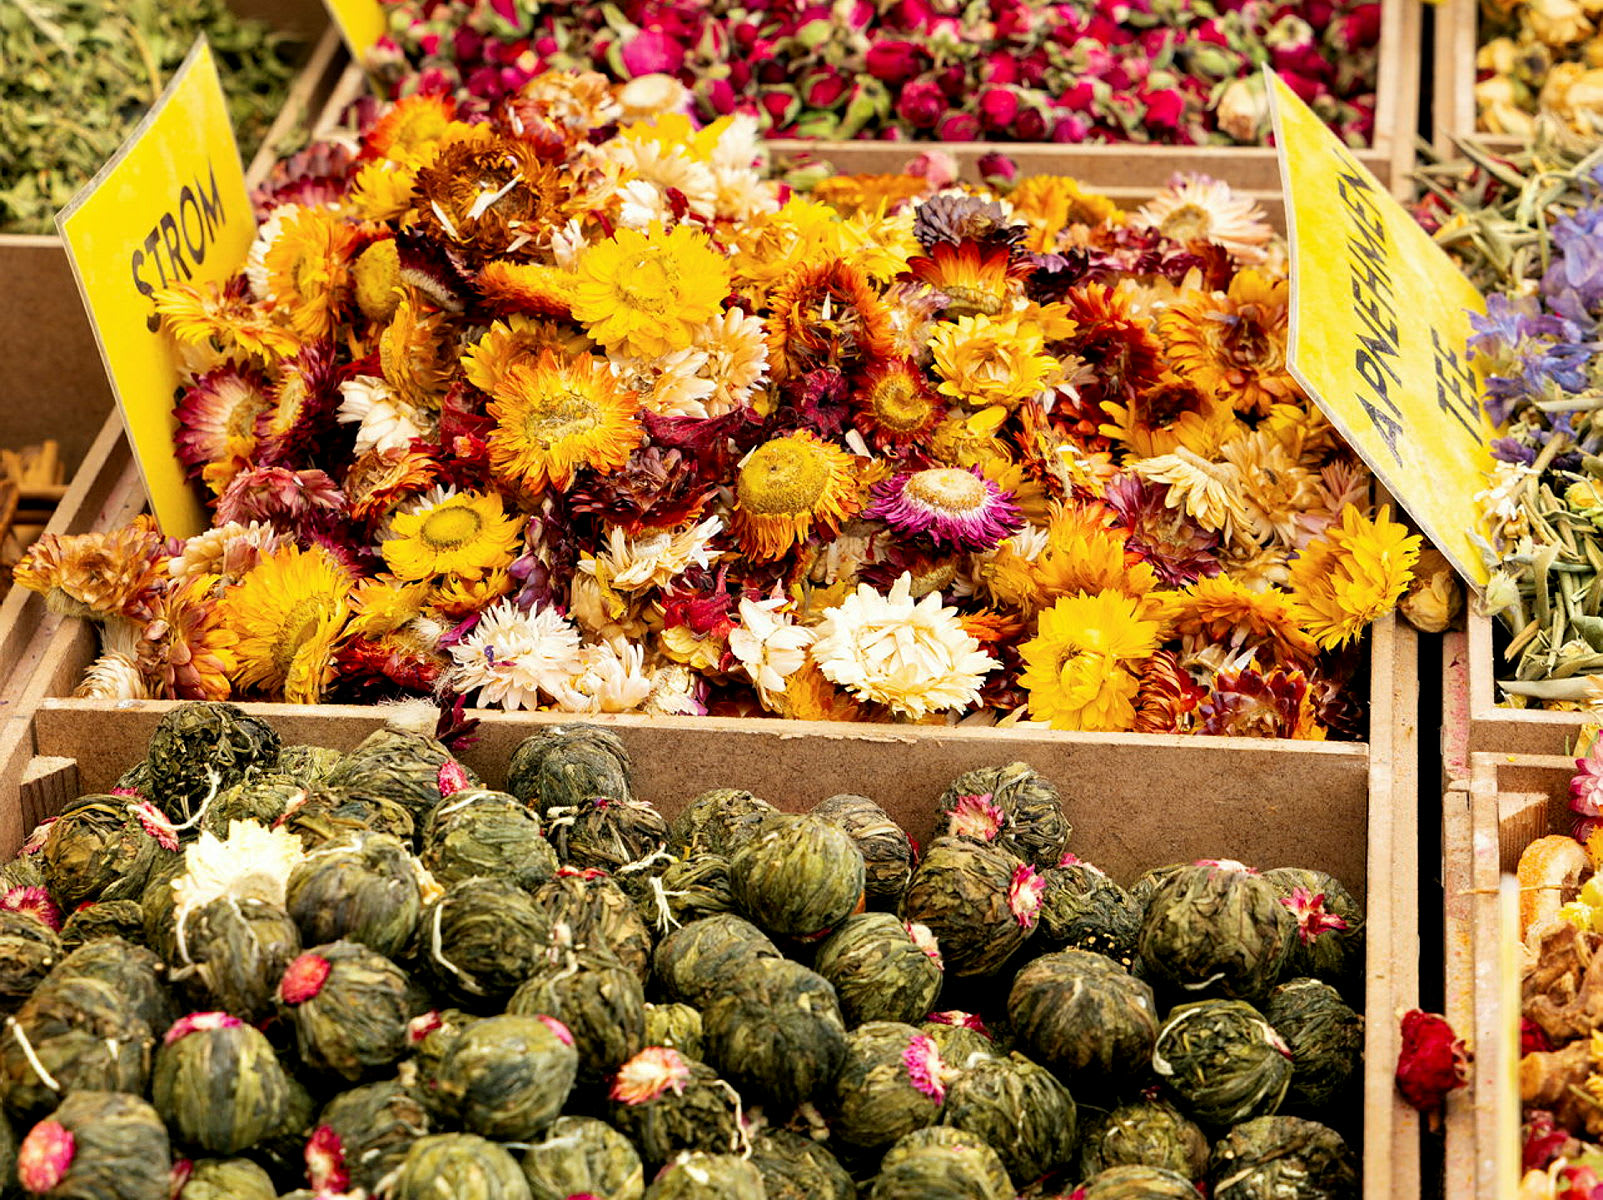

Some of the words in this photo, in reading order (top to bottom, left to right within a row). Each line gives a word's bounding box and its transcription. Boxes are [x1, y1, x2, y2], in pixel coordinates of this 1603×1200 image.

[131, 155, 226, 333] STROM
[1332, 147, 1402, 468] APNEHMEN
[1430, 325, 1483, 447] TEE
